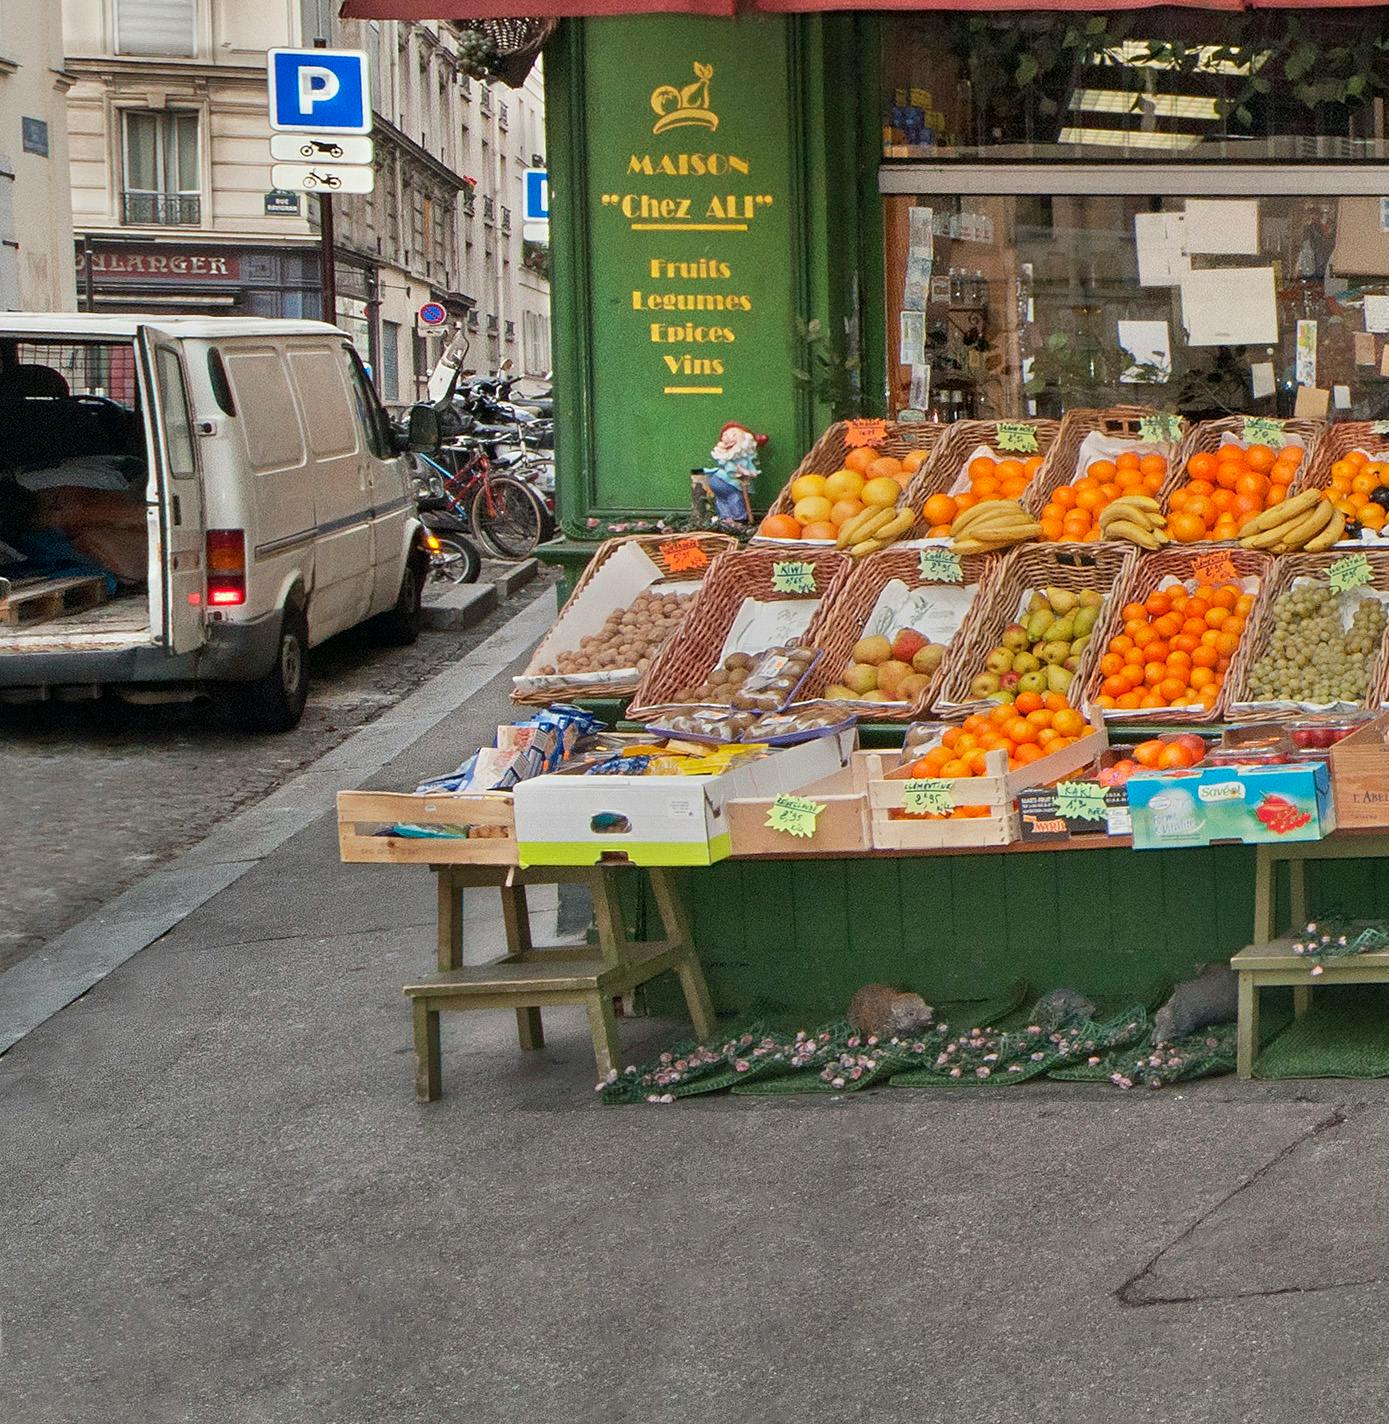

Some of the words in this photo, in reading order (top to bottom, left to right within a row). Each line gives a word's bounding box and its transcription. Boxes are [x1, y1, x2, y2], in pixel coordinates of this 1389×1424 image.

[297, 66, 340, 115] P
[626, 152, 750, 176] MAISON
[649, 258, 732, 279] Fruits
[631, 289, 753, 311] Legumes
[649, 322, 736, 344] Epices
[663, 354, 725, 375] Vins
